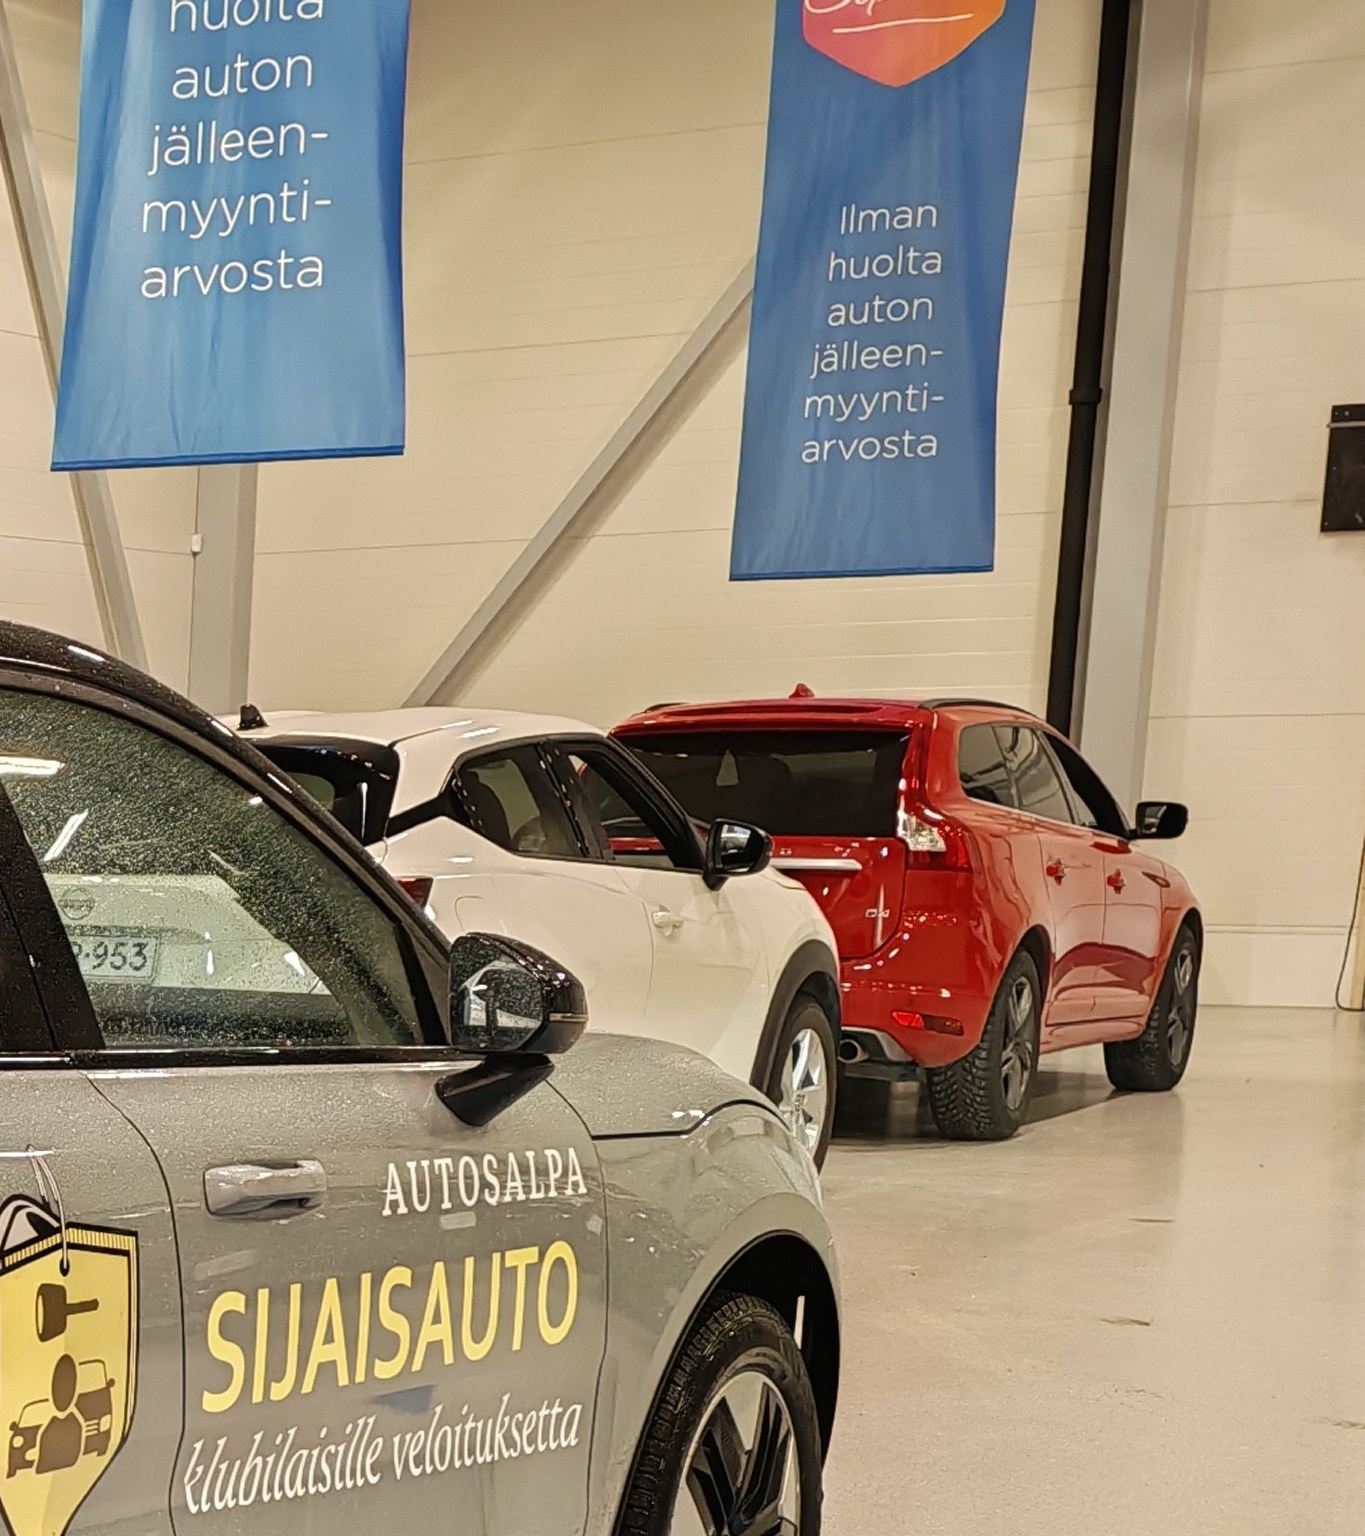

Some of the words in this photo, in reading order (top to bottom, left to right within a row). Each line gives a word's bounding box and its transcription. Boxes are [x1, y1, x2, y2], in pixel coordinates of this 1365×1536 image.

[171, 52, 313, 99] auton
[146, 120, 329, 177] jälleen-
[142, 178, 332, 240] myynti-
[839, 203, 938, 235] Ilman
[140, 249, 324, 299] arvosta
[828, 244, 942, 282] huolta
[827, 295, 933, 327] auton
[809, 339, 944, 380] jälleen-
[803, 382, 944, 422] myynti-
[801, 429, 938, 463] arvosta
[382, 1147, 588, 1216] AUTOSALPA
[201, 1240, 578, 1413] SIJAISAUTO
[183, 1415, 382, 1515] klubilaisille
[392, 1392, 583, 1480] veloituksetta
